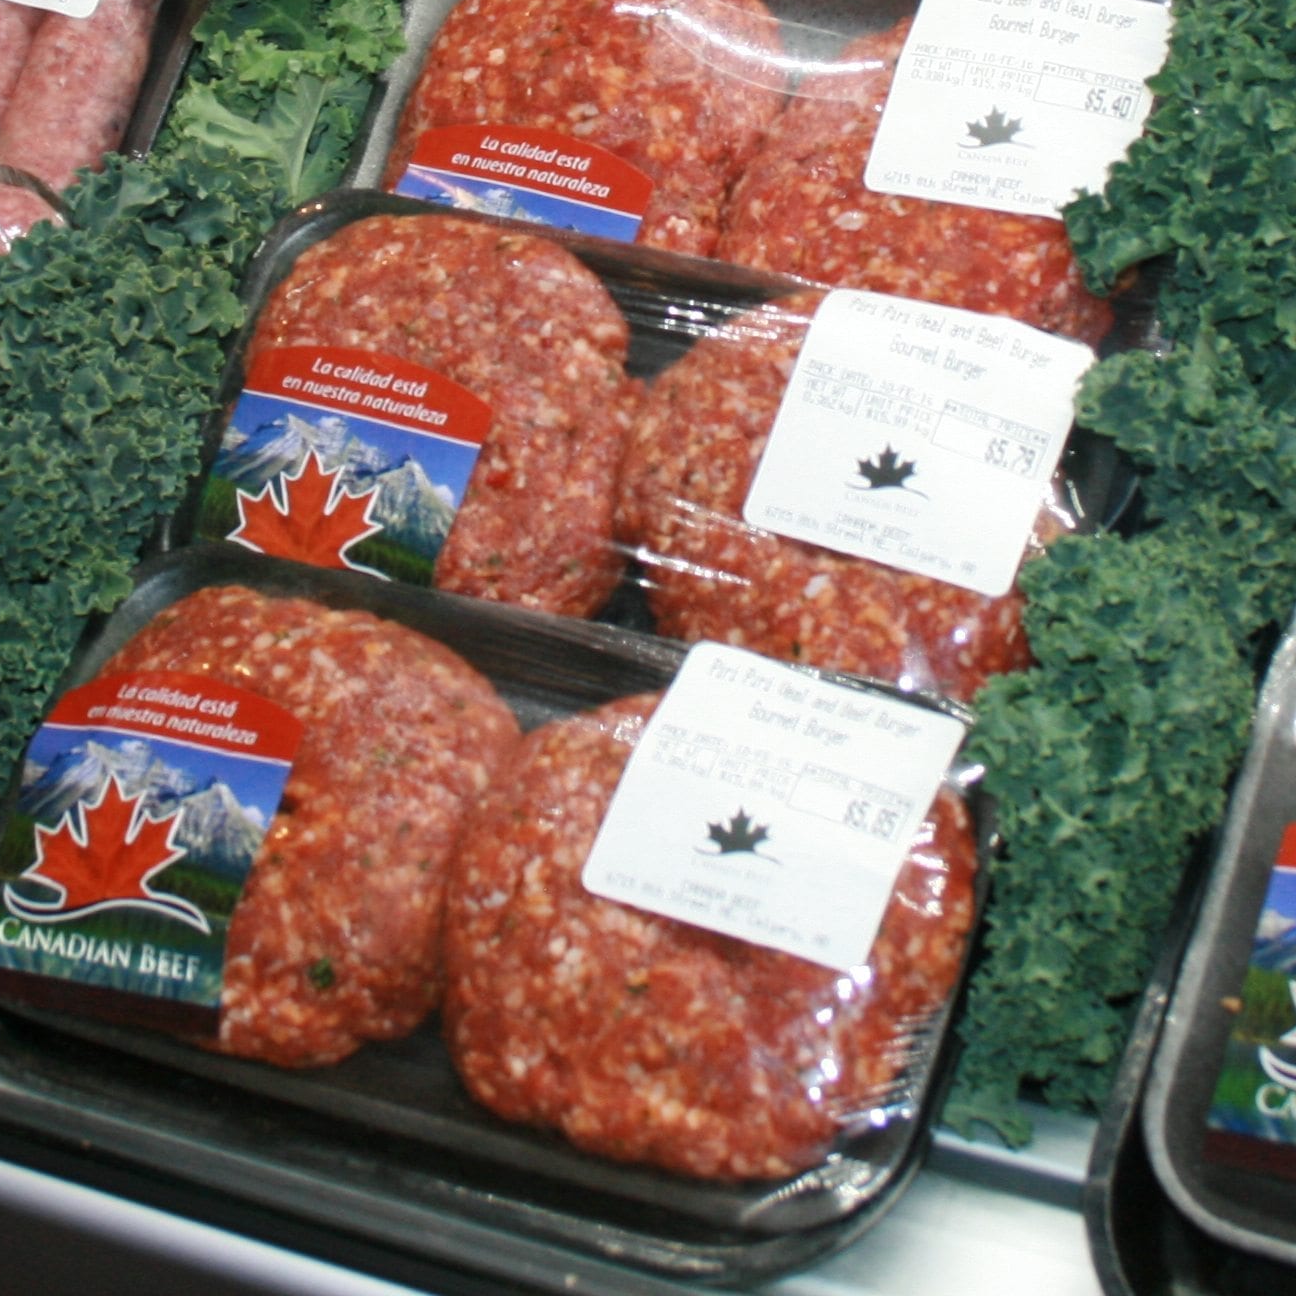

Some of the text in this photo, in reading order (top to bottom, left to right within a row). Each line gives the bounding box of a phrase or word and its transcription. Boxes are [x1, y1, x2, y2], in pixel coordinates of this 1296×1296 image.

[1084, 89, 1132, 118] $5.40
[481, 136, 591, 171] La calidad está
[451, 153, 610, 197] en nuestra naturaleza
[312, 358, 428, 397] La calidad está
[282, 375, 448, 425] en nuestra naturaleza
[118, 685, 238, 718] La calidad está
[88, 705, 258, 745] en nuestra naturaleza
[139, 946, 200, 982] BEEF
